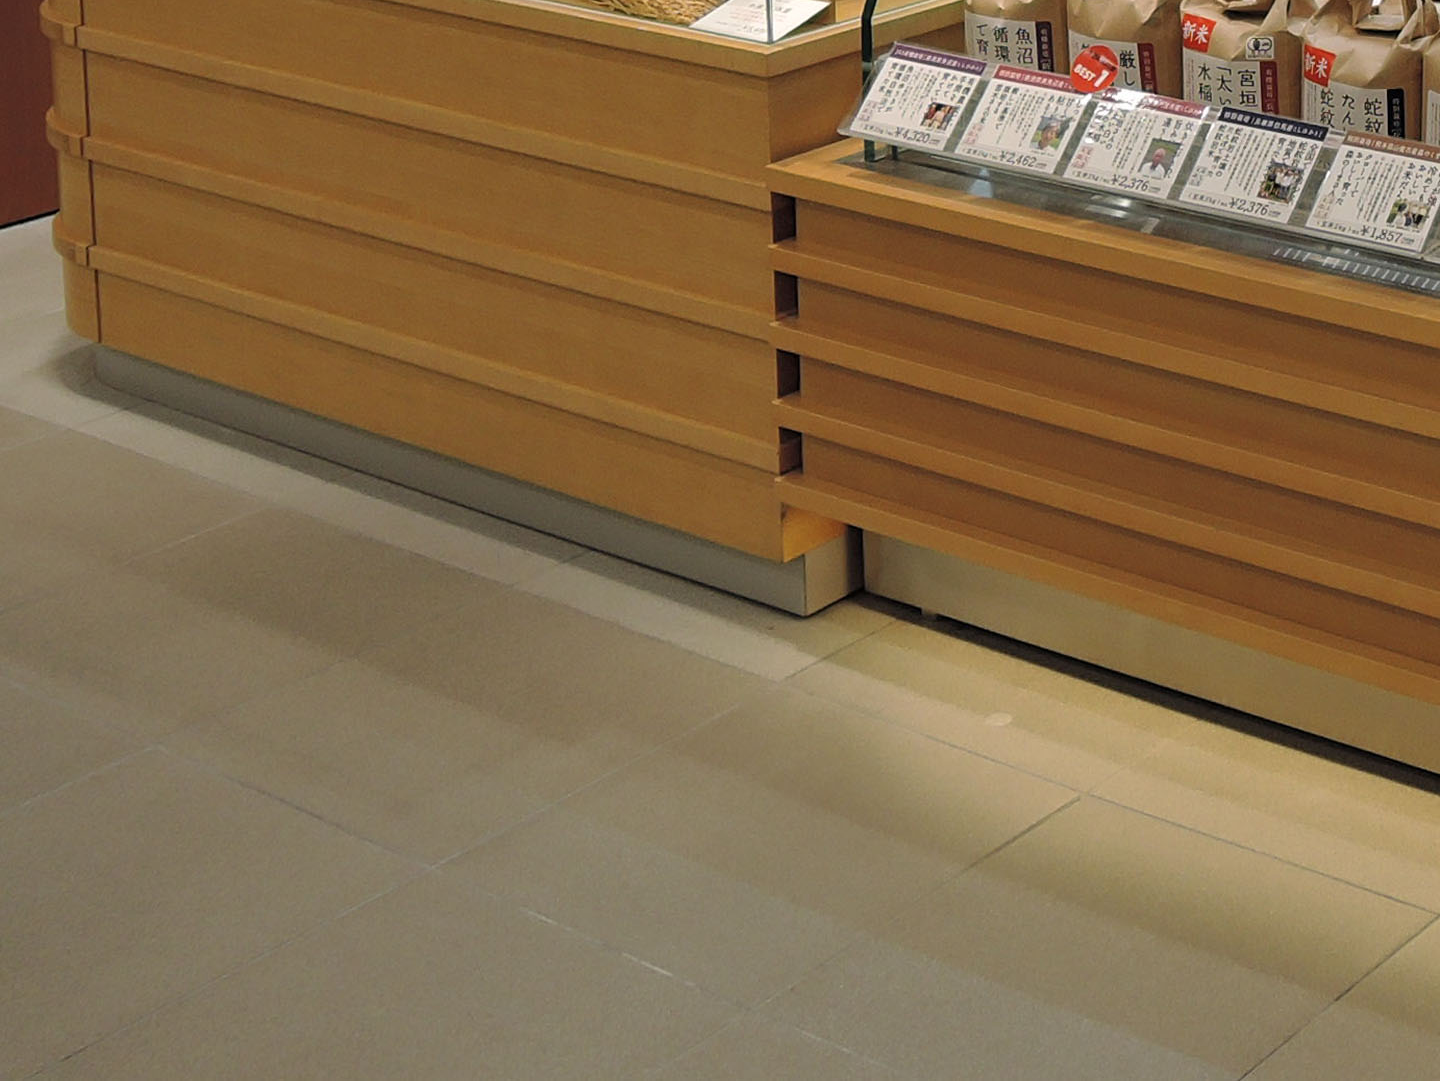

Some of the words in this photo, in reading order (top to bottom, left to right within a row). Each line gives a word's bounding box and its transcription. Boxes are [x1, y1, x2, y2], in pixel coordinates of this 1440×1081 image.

[992, 27, 1011, 64] 循環
[1015, 27, 1034, 65] 魚沼
[1183, 21, 1210, 48] 新米
[1073, 63, 1096, 82] BEST
[1093, 69, 1110, 88] 1
[1119, 49, 1137, 87] 厳し
[1305, 54, 1331, 81] 新米
[1197, 65, 1213, 104] 水稲
[1215, 67, 1233, 107] 「太い
[1237, 69, 1257, 109] 宮垣
[1319, 88, 1336, 129] 蛇紋
[1363, 100, 1385, 136] 蛇紋
[895, 126, 930, 144] ¥4,320
[1000, 150, 1037, 168] ¥2,462
[1111, 174, 1150, 192] ¥2,376
[1230, 197, 1270, 216] ¥2,376
[1360, 224, 1403, 243] ¥1,857
